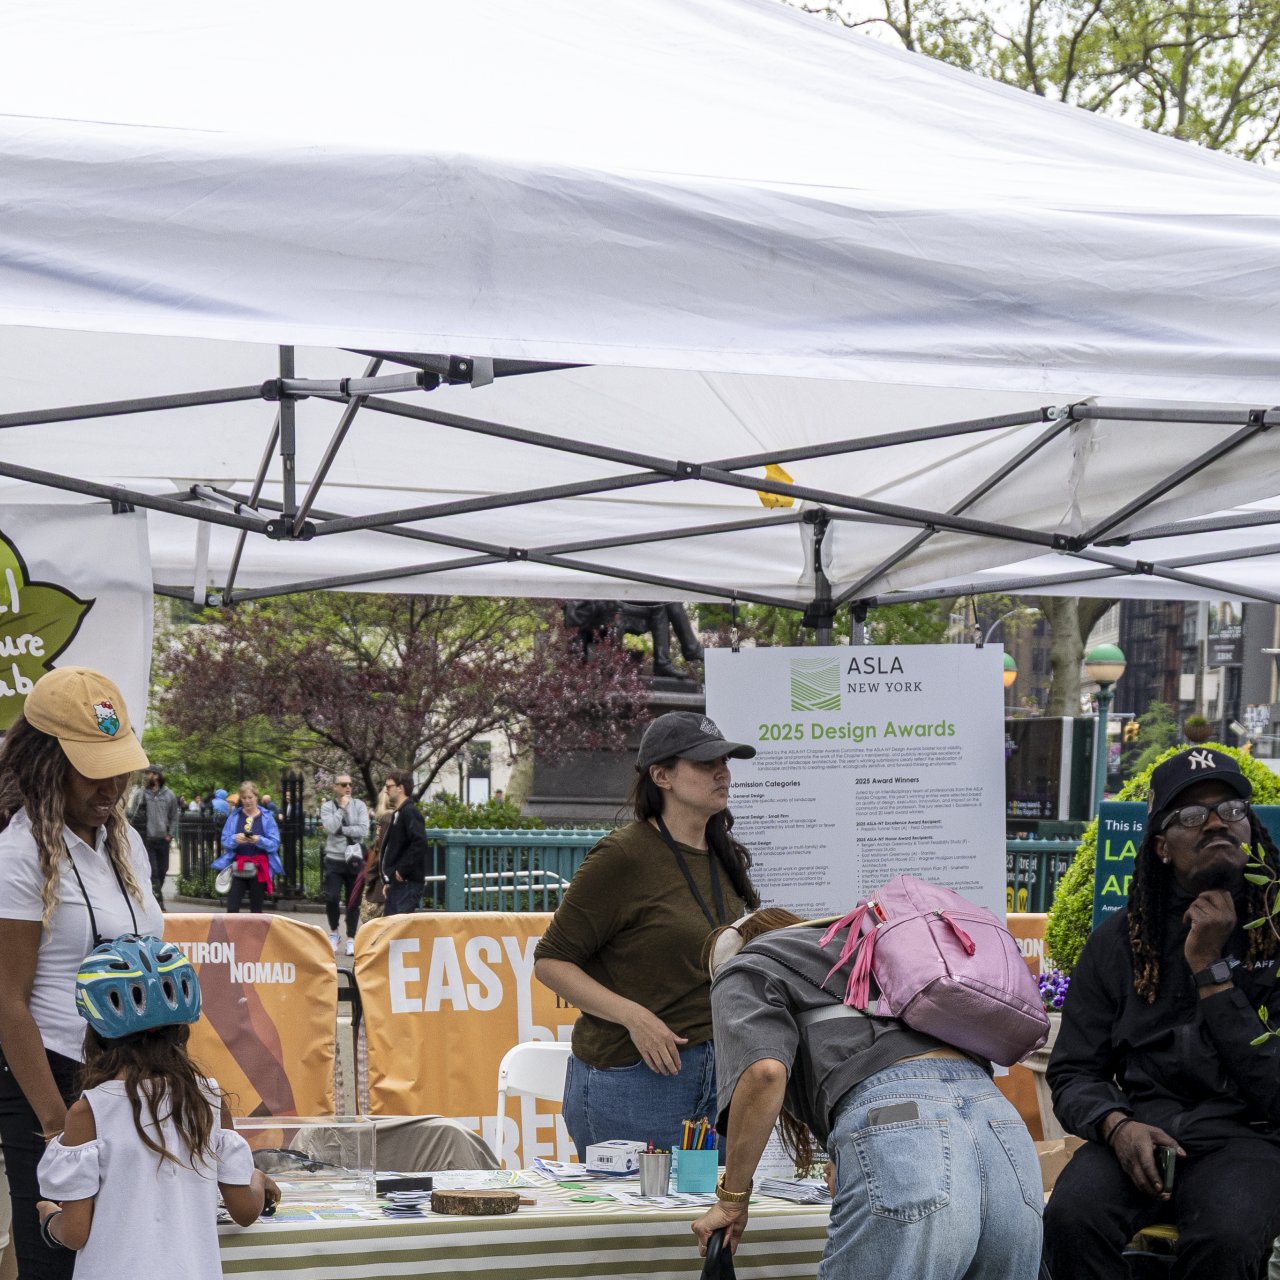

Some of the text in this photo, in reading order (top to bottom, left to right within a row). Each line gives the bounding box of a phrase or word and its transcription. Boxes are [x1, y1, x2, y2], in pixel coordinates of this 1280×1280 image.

[847, 656, 904, 674] ASLA
[847, 681, 923, 693] NEW YORK
[758, 719, 955, 743] 2025 Design Awards
[765, 779, 801, 789] Categories
[895, 776, 920, 784] Winners
[1105, 819, 1143, 831] This is
[230, 962, 296, 984] NOMAD
[388, 936, 540, 1013] EASY
